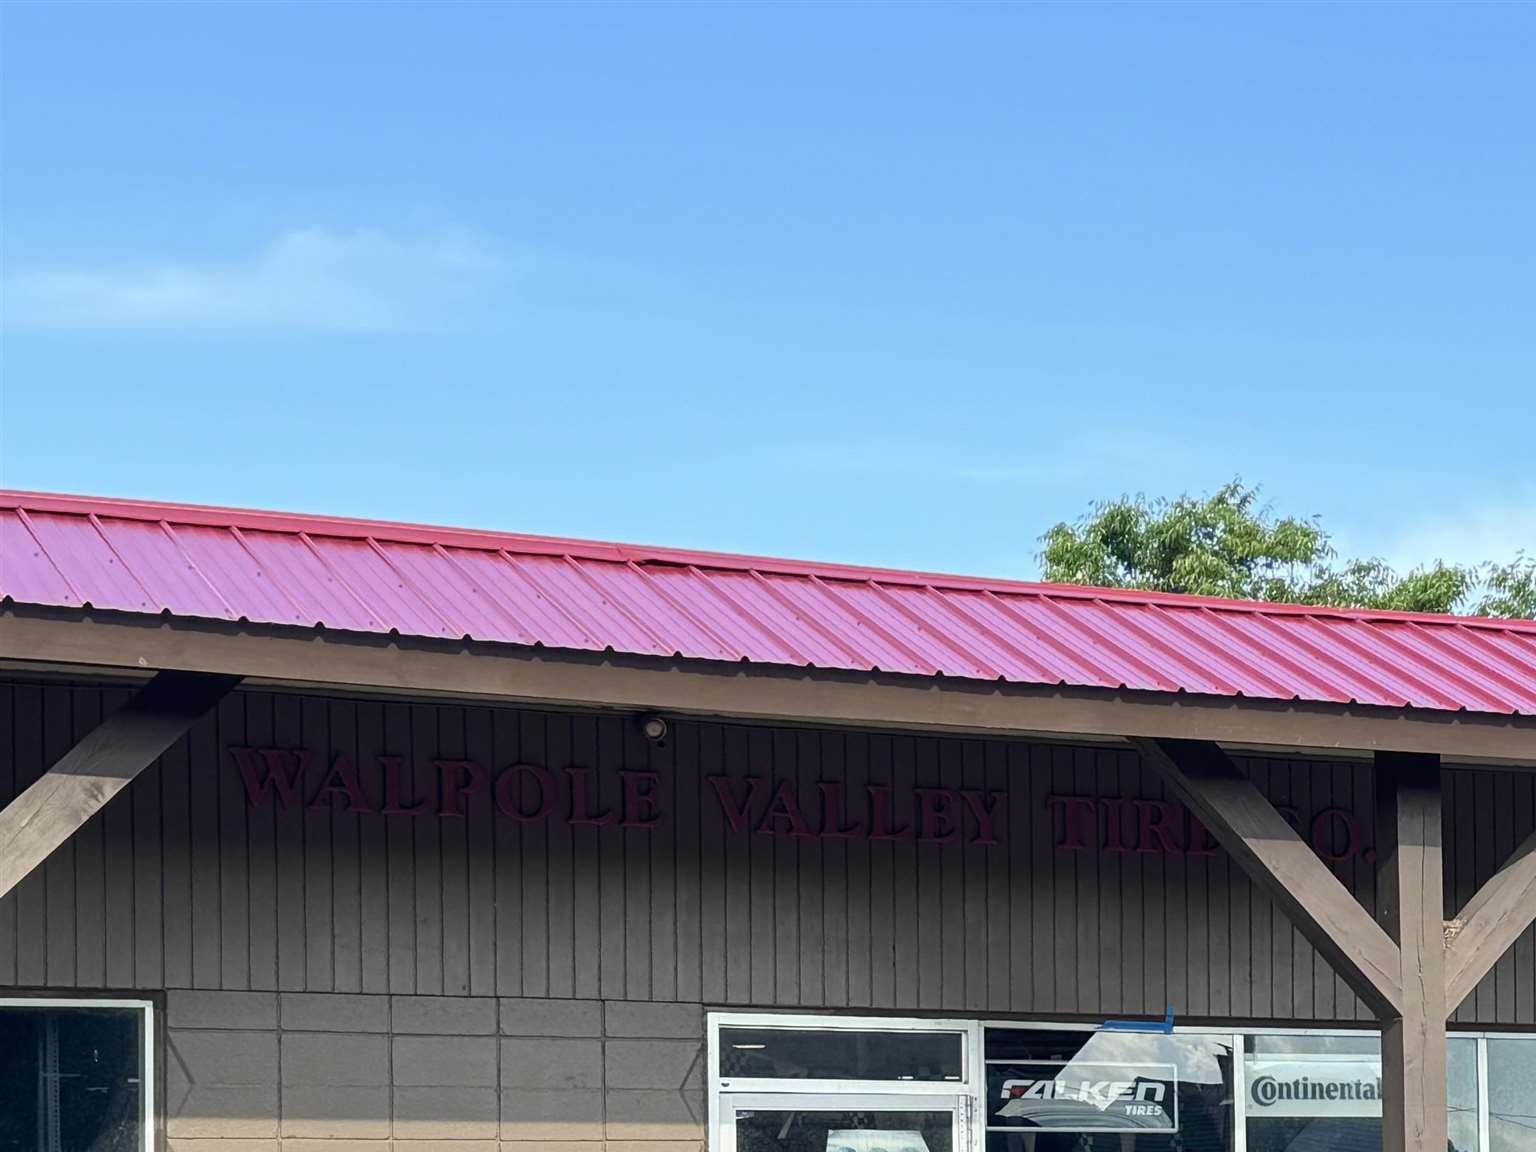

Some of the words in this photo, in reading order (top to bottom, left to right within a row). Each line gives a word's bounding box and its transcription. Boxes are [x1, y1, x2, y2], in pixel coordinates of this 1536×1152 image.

[227, 744, 663, 829] WALPOLE
[706, 774, 1008, 846] VALLEY
[1001, 1079, 1166, 1112] FALKEN
[1125, 1105, 1162, 1115] TIRES
